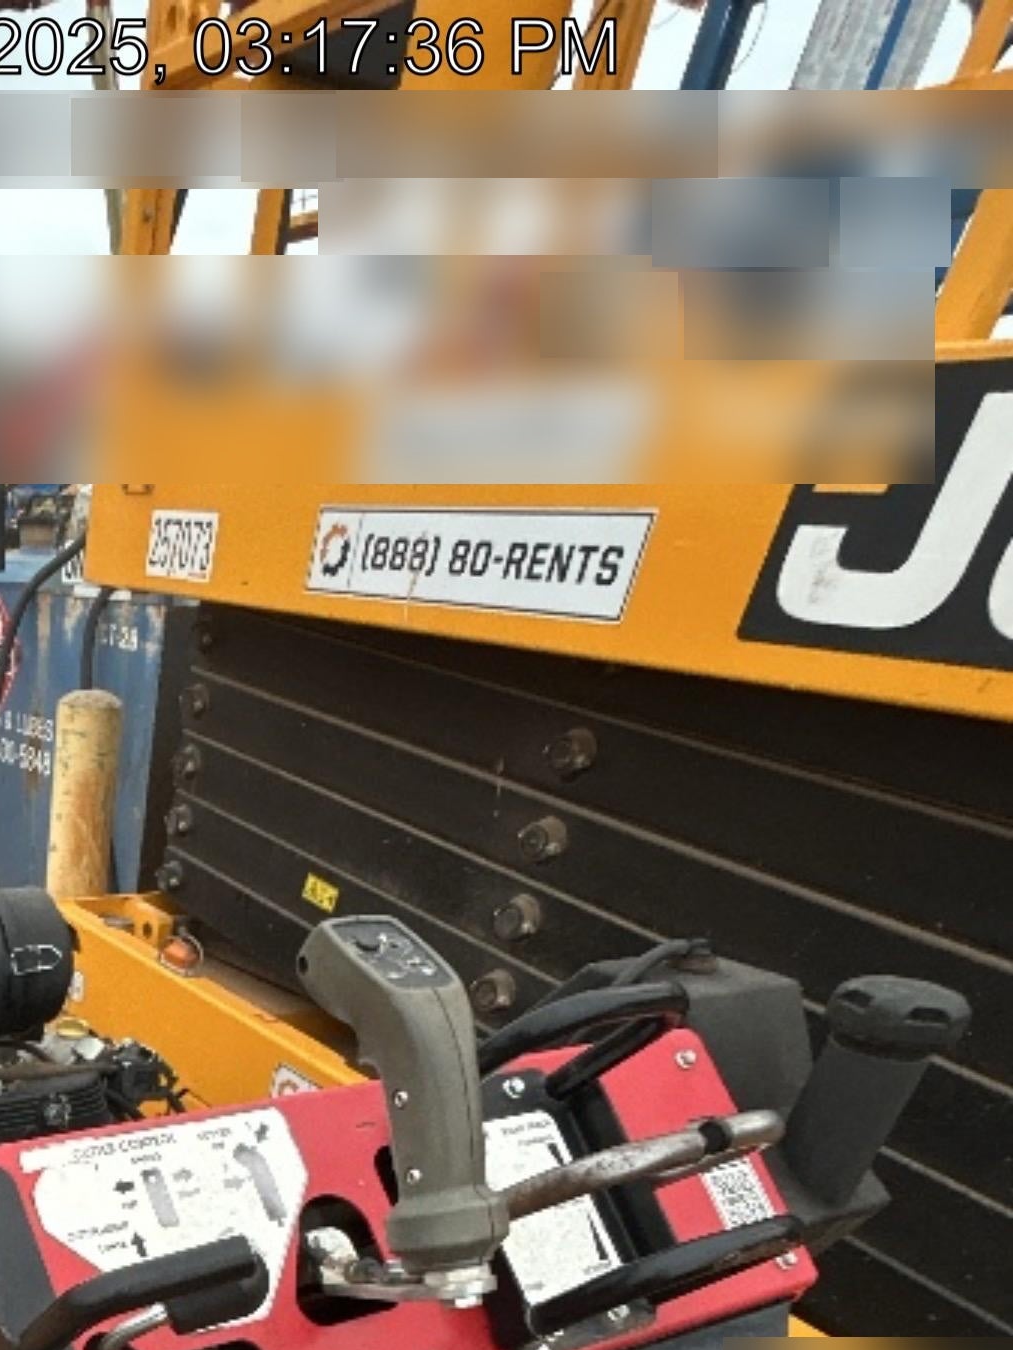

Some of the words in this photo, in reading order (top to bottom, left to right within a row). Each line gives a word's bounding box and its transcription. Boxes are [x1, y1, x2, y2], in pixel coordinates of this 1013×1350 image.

[148, 516, 214, 571] 257073
[361, 532, 442, 577] (888)
[447, 539, 625, 587] 80-RENTS
